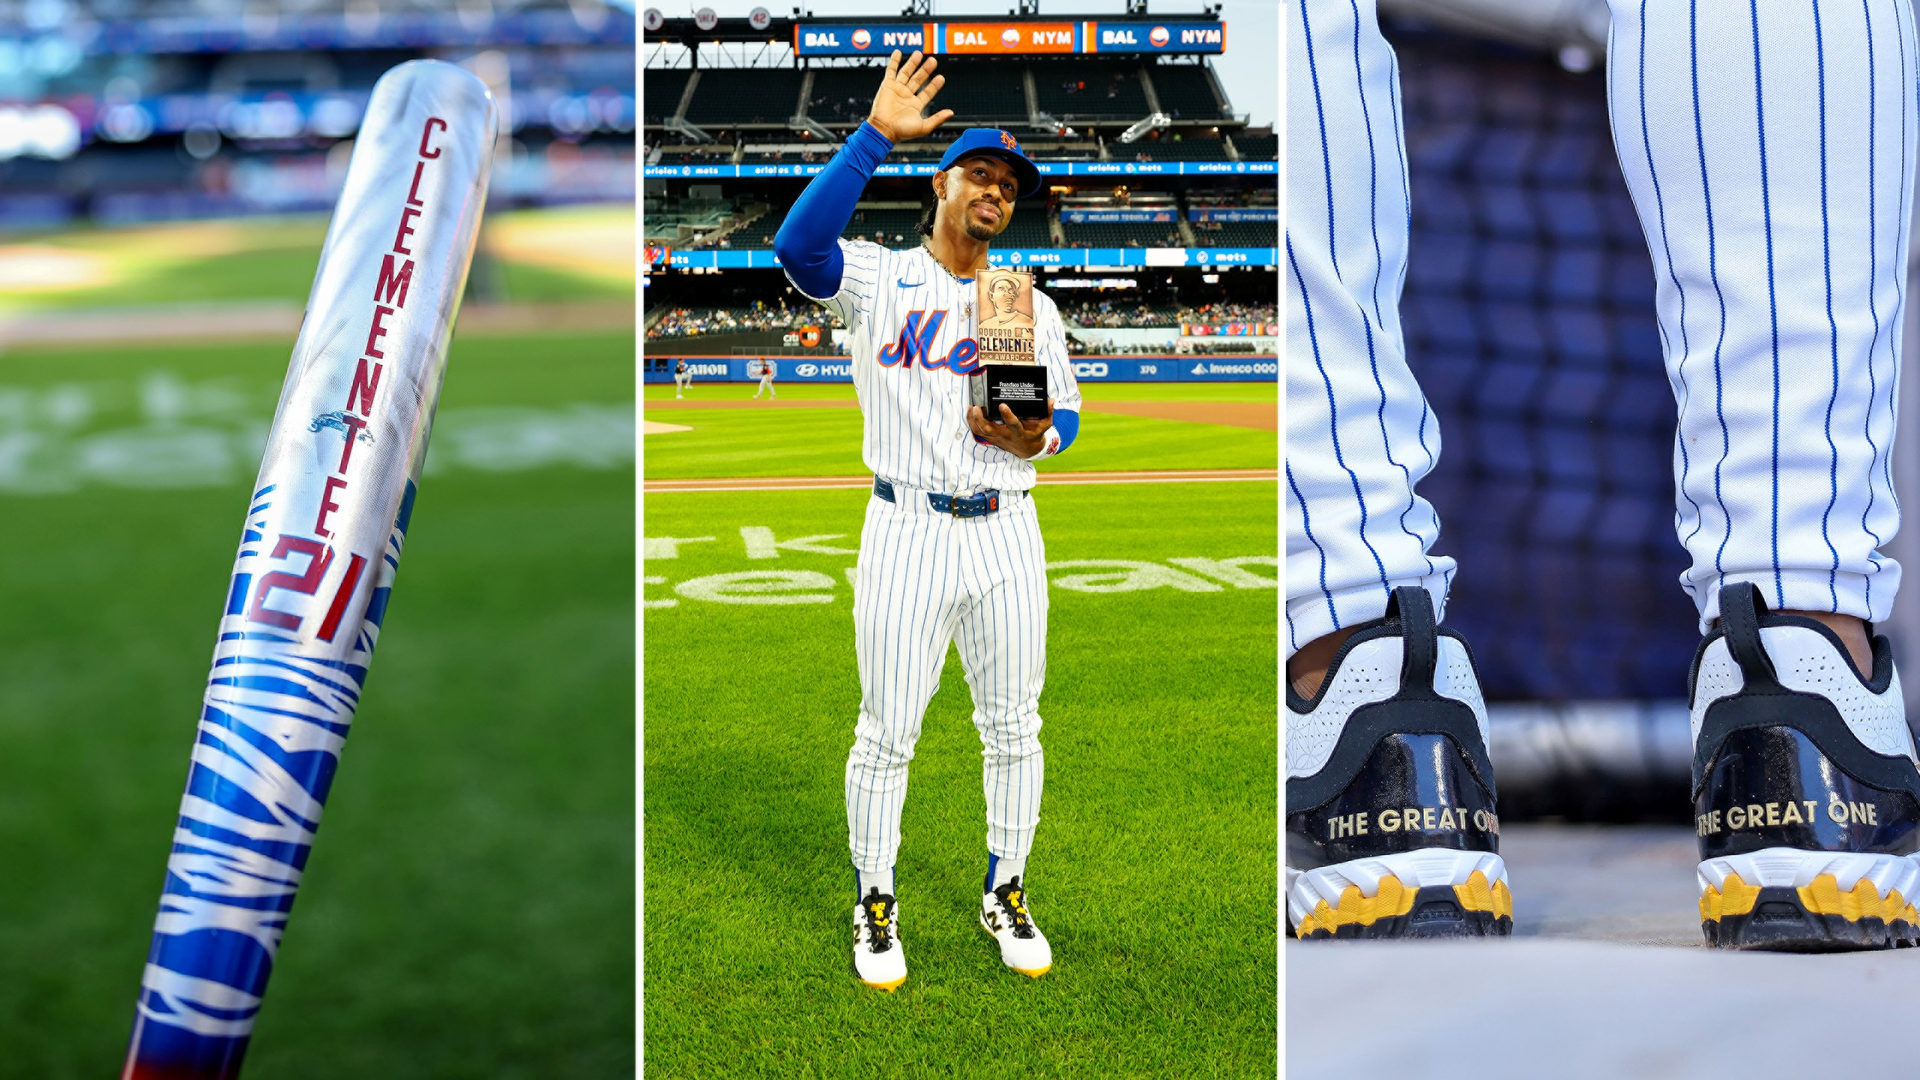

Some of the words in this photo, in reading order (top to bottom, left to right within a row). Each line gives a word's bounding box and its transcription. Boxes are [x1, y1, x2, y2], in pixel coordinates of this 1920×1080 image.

[753, 13, 766, 24] 42
[804, 33, 840, 46] BAL
[883, 32, 923, 46] NYM
[953, 32, 987, 45] BAL
[1032, 31, 1072, 45] NYM
[1102, 30, 1138, 44] BAL
[1181, 29, 1221, 43] NYM
[695, 167, 719, 175] mets
[1138, 164, 1162, 172] mets
[1249, 164, 1274, 172] mets
[1029, 253, 1060, 263] mets
[1215, 252, 1247, 262] mets
[314, 117, 447, 541] CLEMENTE
[978, 327, 1012, 338] ROBERTO
[877, 309, 987, 376] Me
[979, 337, 1034, 353] CLEMENTE
[994, 353, 1020, 361] AWARD
[821, 365, 852, 376] HYU
[1140, 365, 1158, 375] 370
[1209, 363, 1252, 374] Invesco
[248, 533, 368, 644] 21
[1327, 811, 1368, 840] THE
[1377, 807, 1468, 833] GREAT
[1696, 809, 1721, 838] THE
[1726, 800, 1818, 830] GREAT
[1827, 799, 1878, 827] ONE
